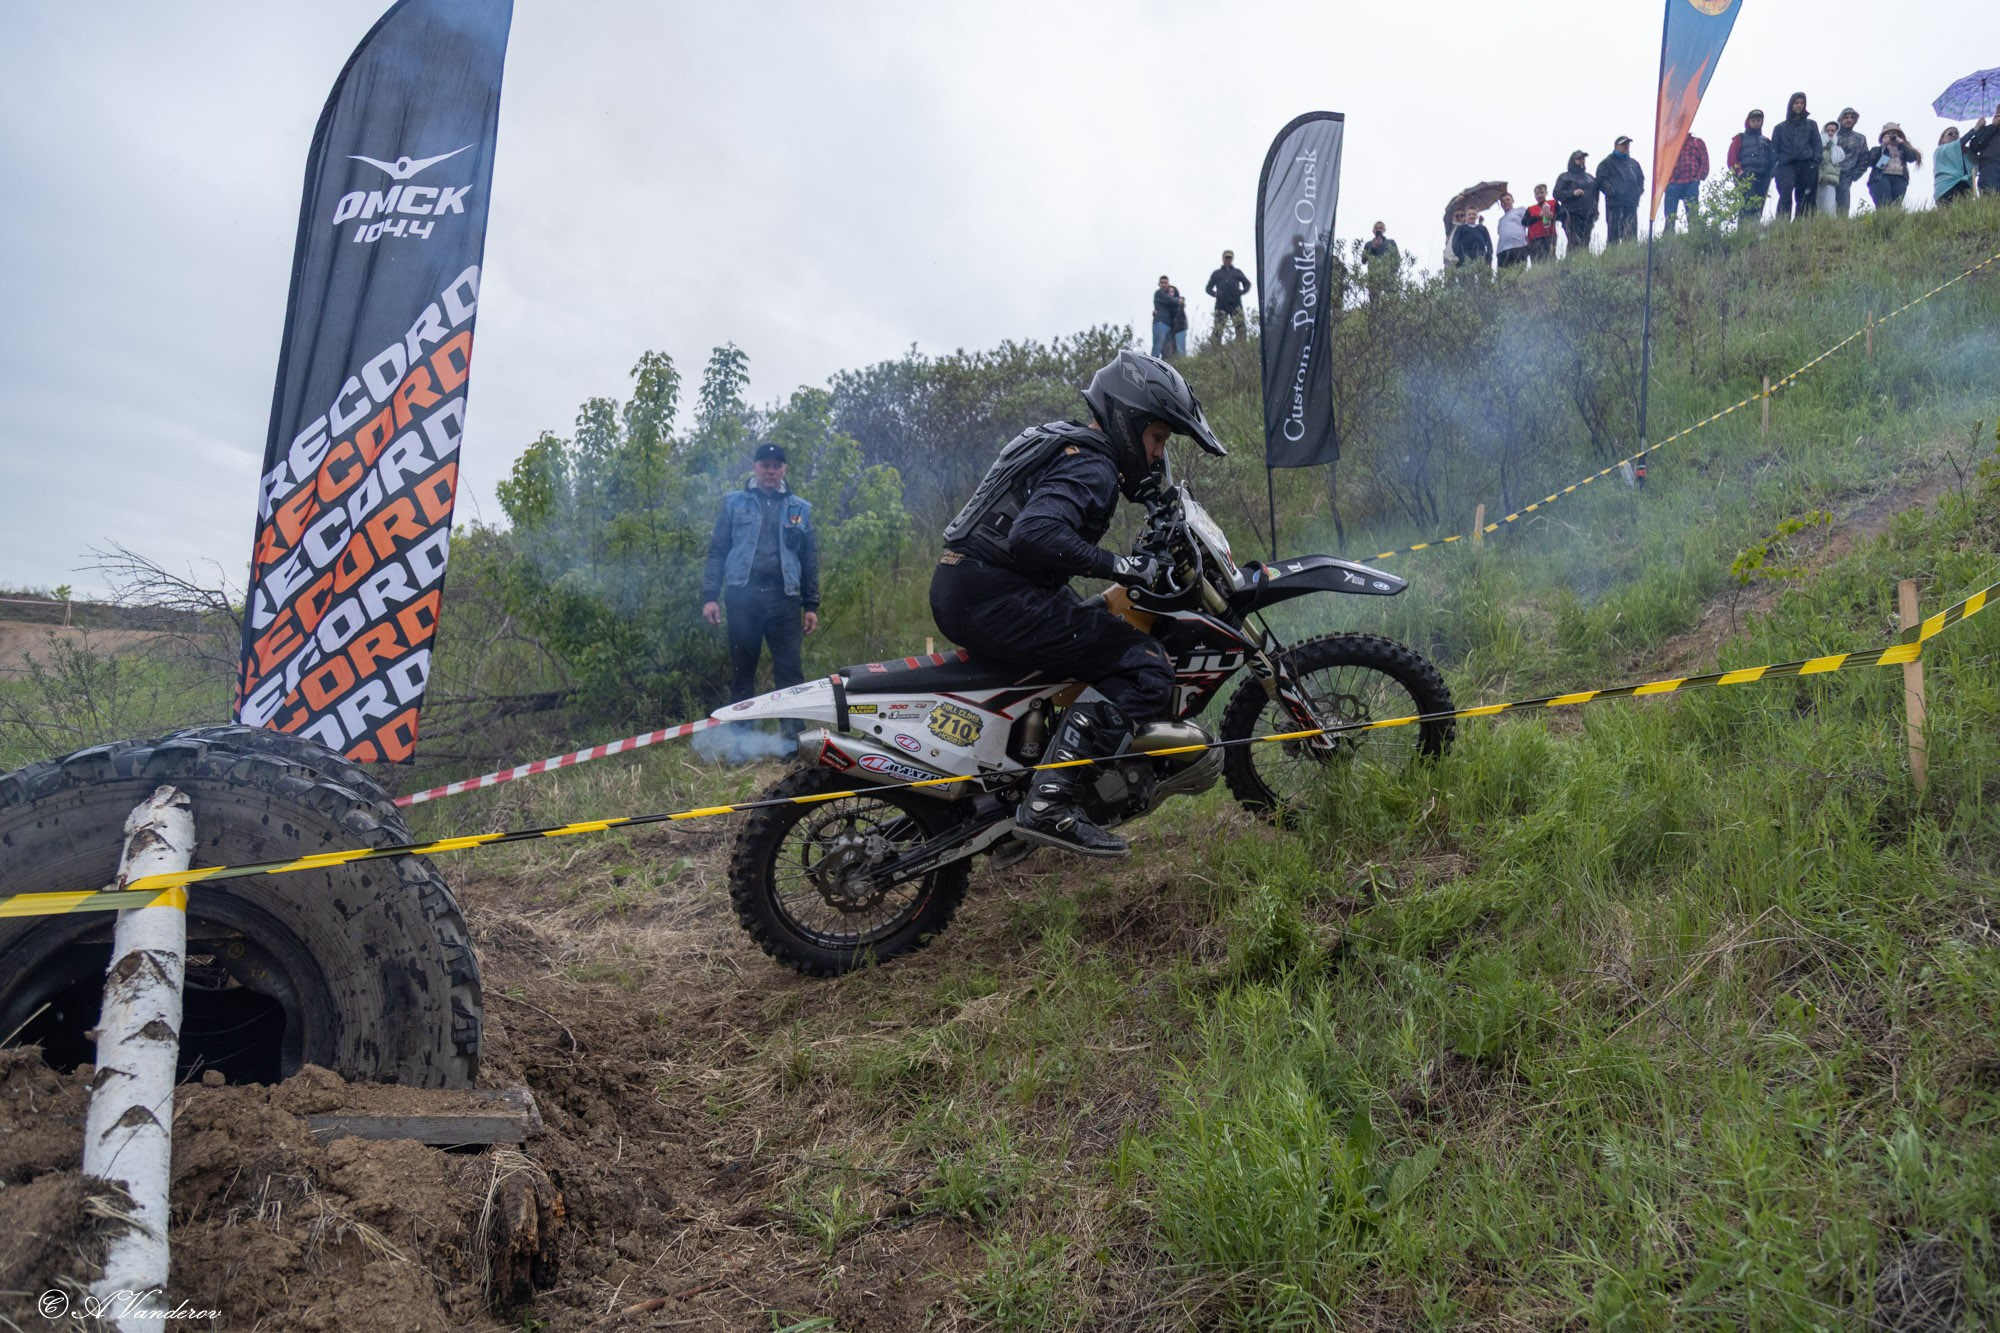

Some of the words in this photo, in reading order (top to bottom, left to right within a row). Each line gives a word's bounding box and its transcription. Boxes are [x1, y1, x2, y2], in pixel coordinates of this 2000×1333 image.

[352, 217, 435, 244] 104.4
[258, 264, 482, 522] RECORD
[942, 701, 959, 714] HILL
[938, 713, 973, 740] 710
[938, 732, 964, 747] HOBBY
